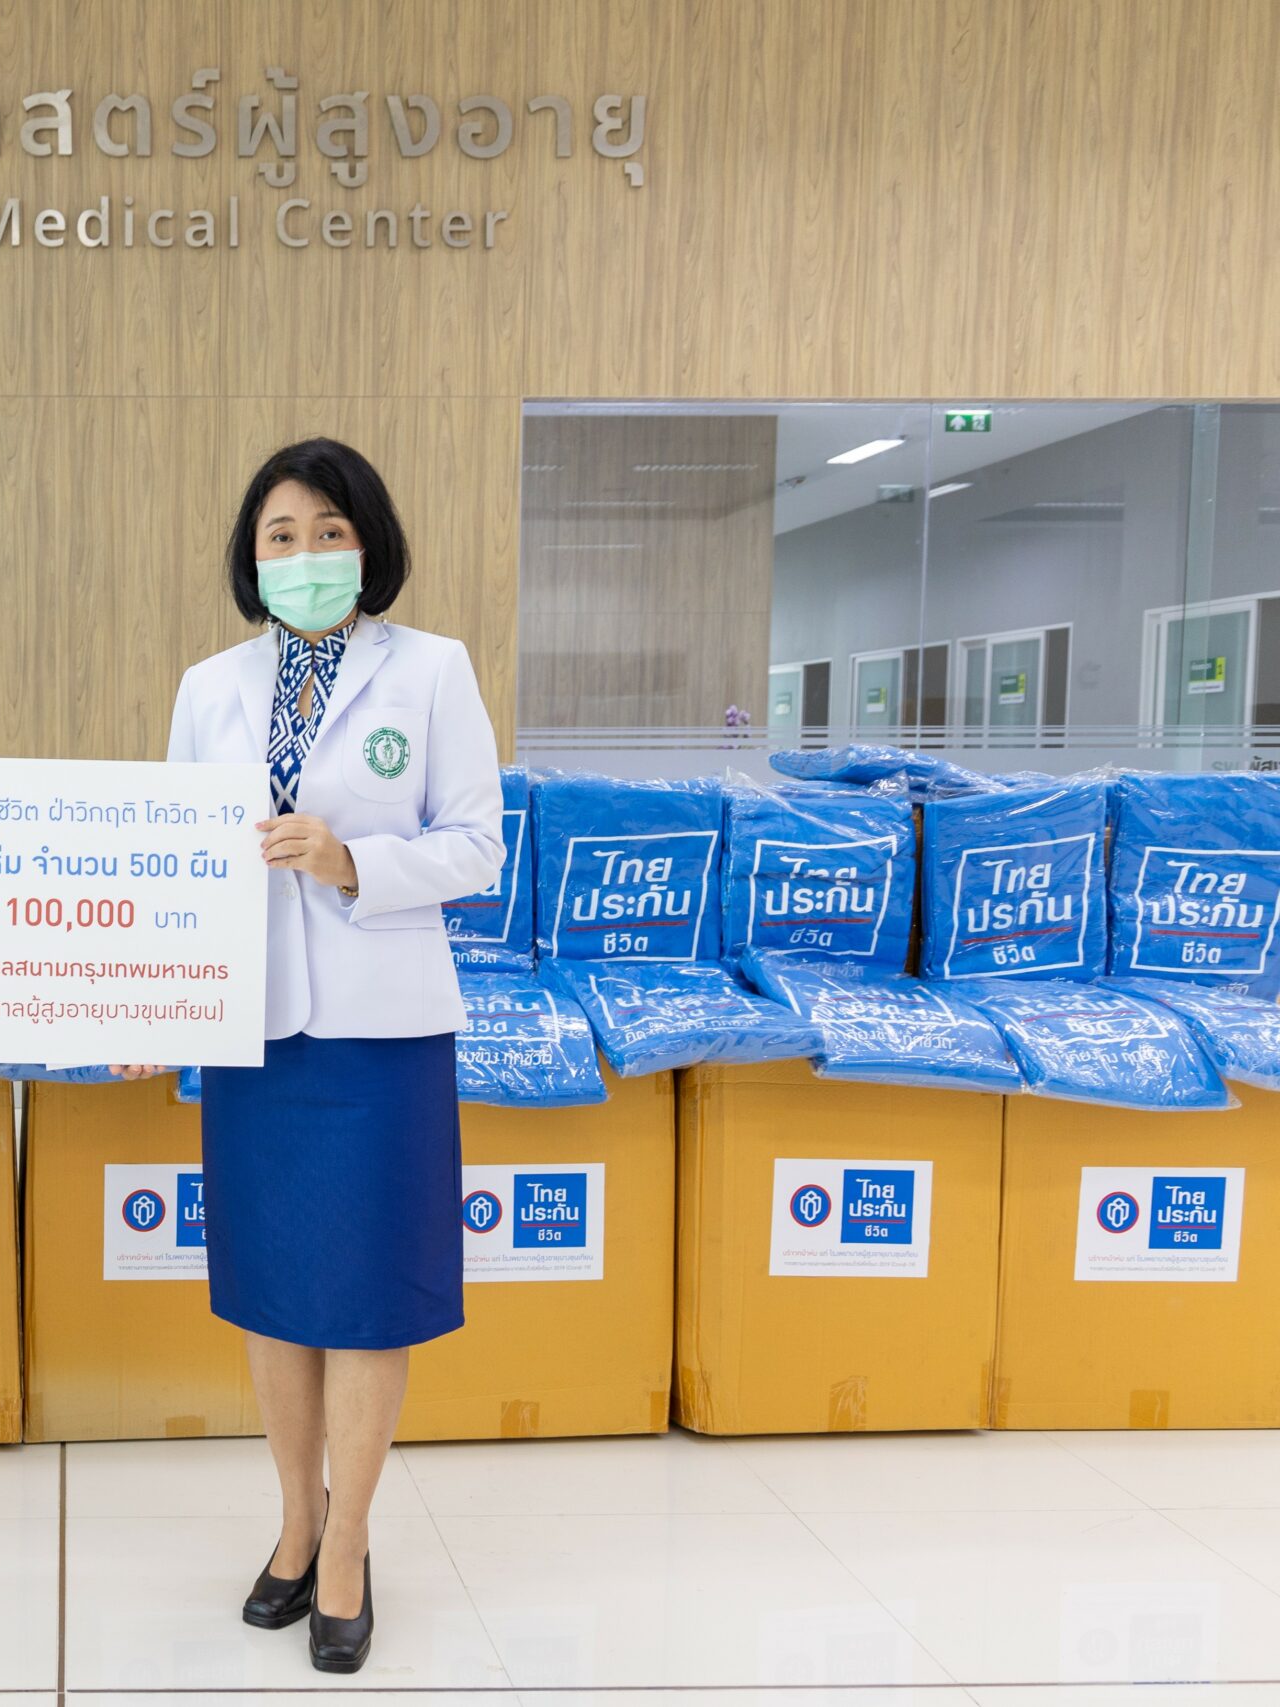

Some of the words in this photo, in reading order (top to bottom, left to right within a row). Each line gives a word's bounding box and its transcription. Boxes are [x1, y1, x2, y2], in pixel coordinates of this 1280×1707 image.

[275, 196, 512, 250] Center
[49, 797, 136, 828] ฝ่าวิกฤติ
[145, 800, 197, 824] โควิด
[207, 805, 245, 825] -19
[32, 845, 118, 876] จำนวน
[130, 853, 178, 877] 500
[190, 850, 228, 879] ผืน
[592, 850, 673, 885] ไทย
[981, 859, 1052, 895] ไทย
[1166, 860, 1247, 895] ไทย
[572, 884, 691, 921] ประกัน
[967, 890, 1072, 932] ปรกัน
[1149, 896, 1264, 928] ประกัน
[6, 897, 135, 932] 100,000
[155, 910, 197, 929] บาท
[604, 932, 649, 954] ชีวิต
[1182, 941, 1222, 964] ชีวิต
[992, 944, 1036, 965] ชีวิต
[526, 1183, 567, 1203] ไทย
[856, 1178, 895, 1199] ไทย
[1165, 1185, 1206, 1205] ไทย
[521, 1203, 579, 1221] ประกัน
[849, 1199, 906, 1218] ประกัน
[1157, 1206, 1217, 1223] ประกัน
[537, 1229, 562, 1241] ชีวิต
[864, 1225, 889, 1237] ชีวิต
[1173, 1231, 1198, 1243] ชีวิต
